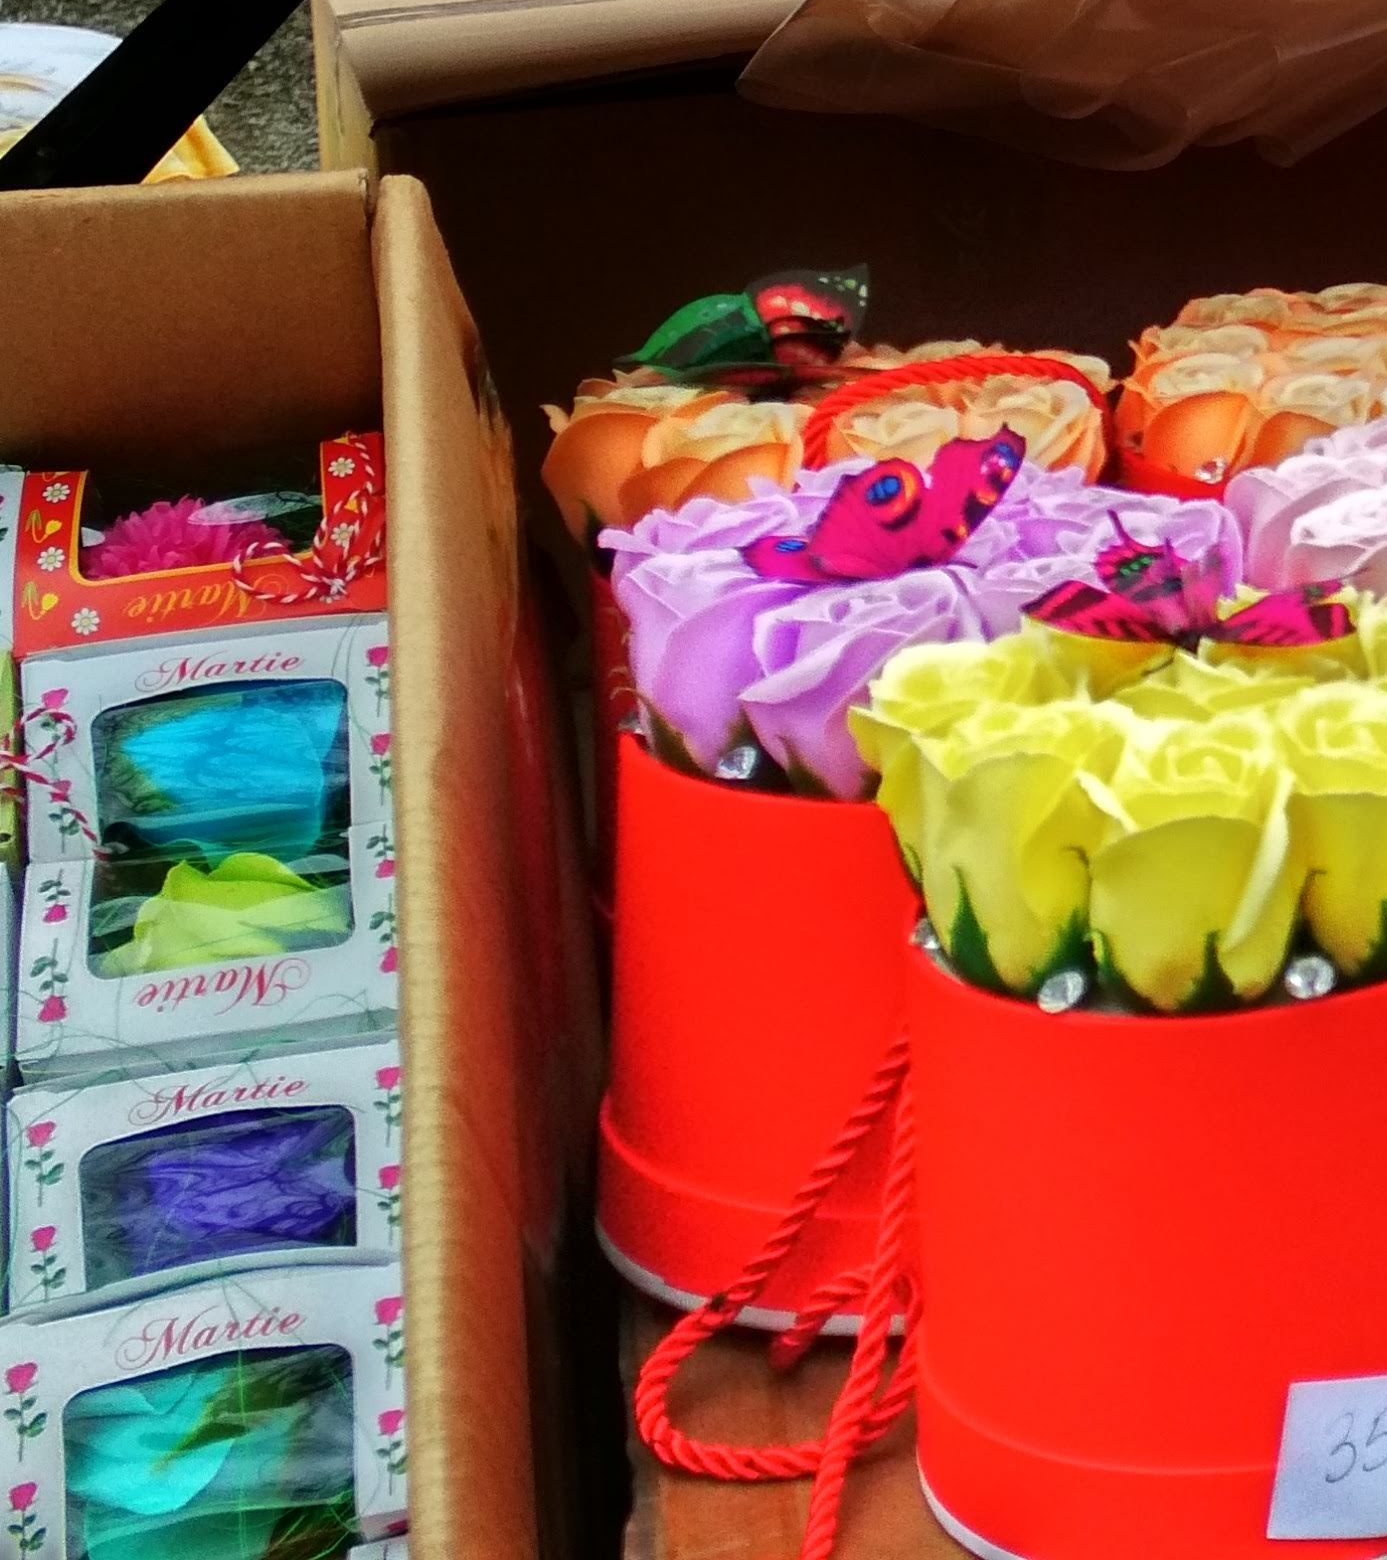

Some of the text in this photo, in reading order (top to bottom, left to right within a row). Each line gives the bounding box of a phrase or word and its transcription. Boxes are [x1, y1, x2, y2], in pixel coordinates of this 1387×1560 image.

[134, 650, 304, 693] Martie
[132, 956, 311, 1018] Martie
[127, 1074, 311, 1128] Martie
[114, 1303, 309, 1372] Martie
